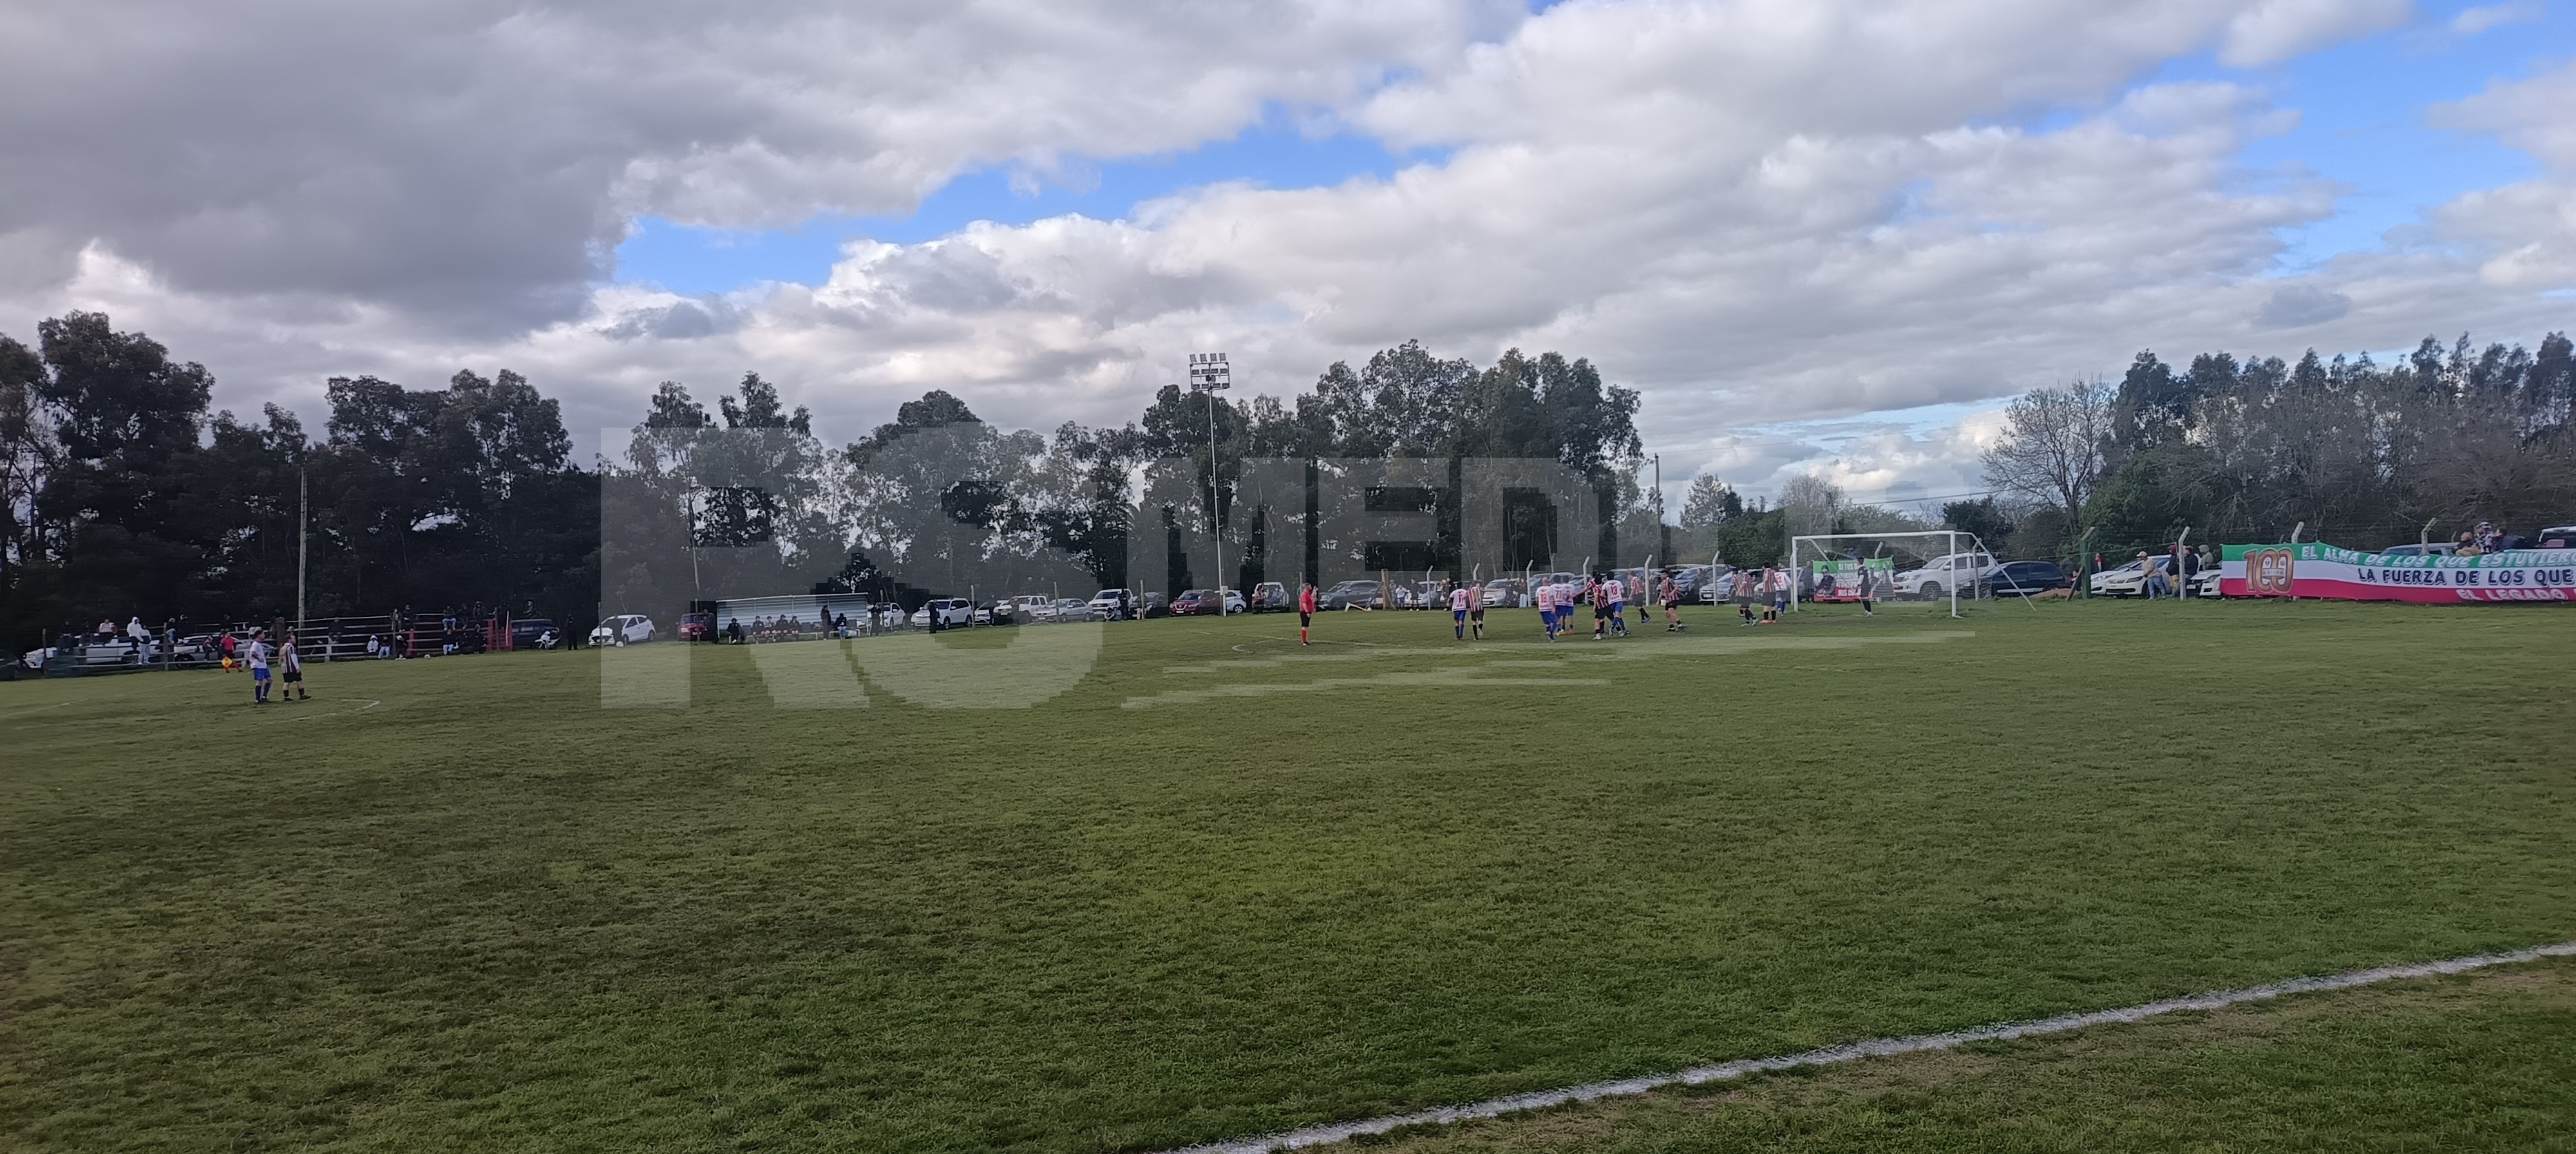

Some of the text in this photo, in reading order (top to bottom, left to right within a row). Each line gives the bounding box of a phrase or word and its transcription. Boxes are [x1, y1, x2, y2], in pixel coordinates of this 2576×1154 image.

[2301, 546, 2318, 560] EL
[2324, 547, 2359, 564] ALMA
[2364, 554, 2391, 566] DE
[2392, 556, 2428, 567] LOS
[2434, 555, 2472, 569] QUE
[2243, 547, 2295, 593] 100
[2358, 568, 2575, 588] LA FUERZA DE LOS QUE
[2456, 589, 2569, 601] EL LEGADO
